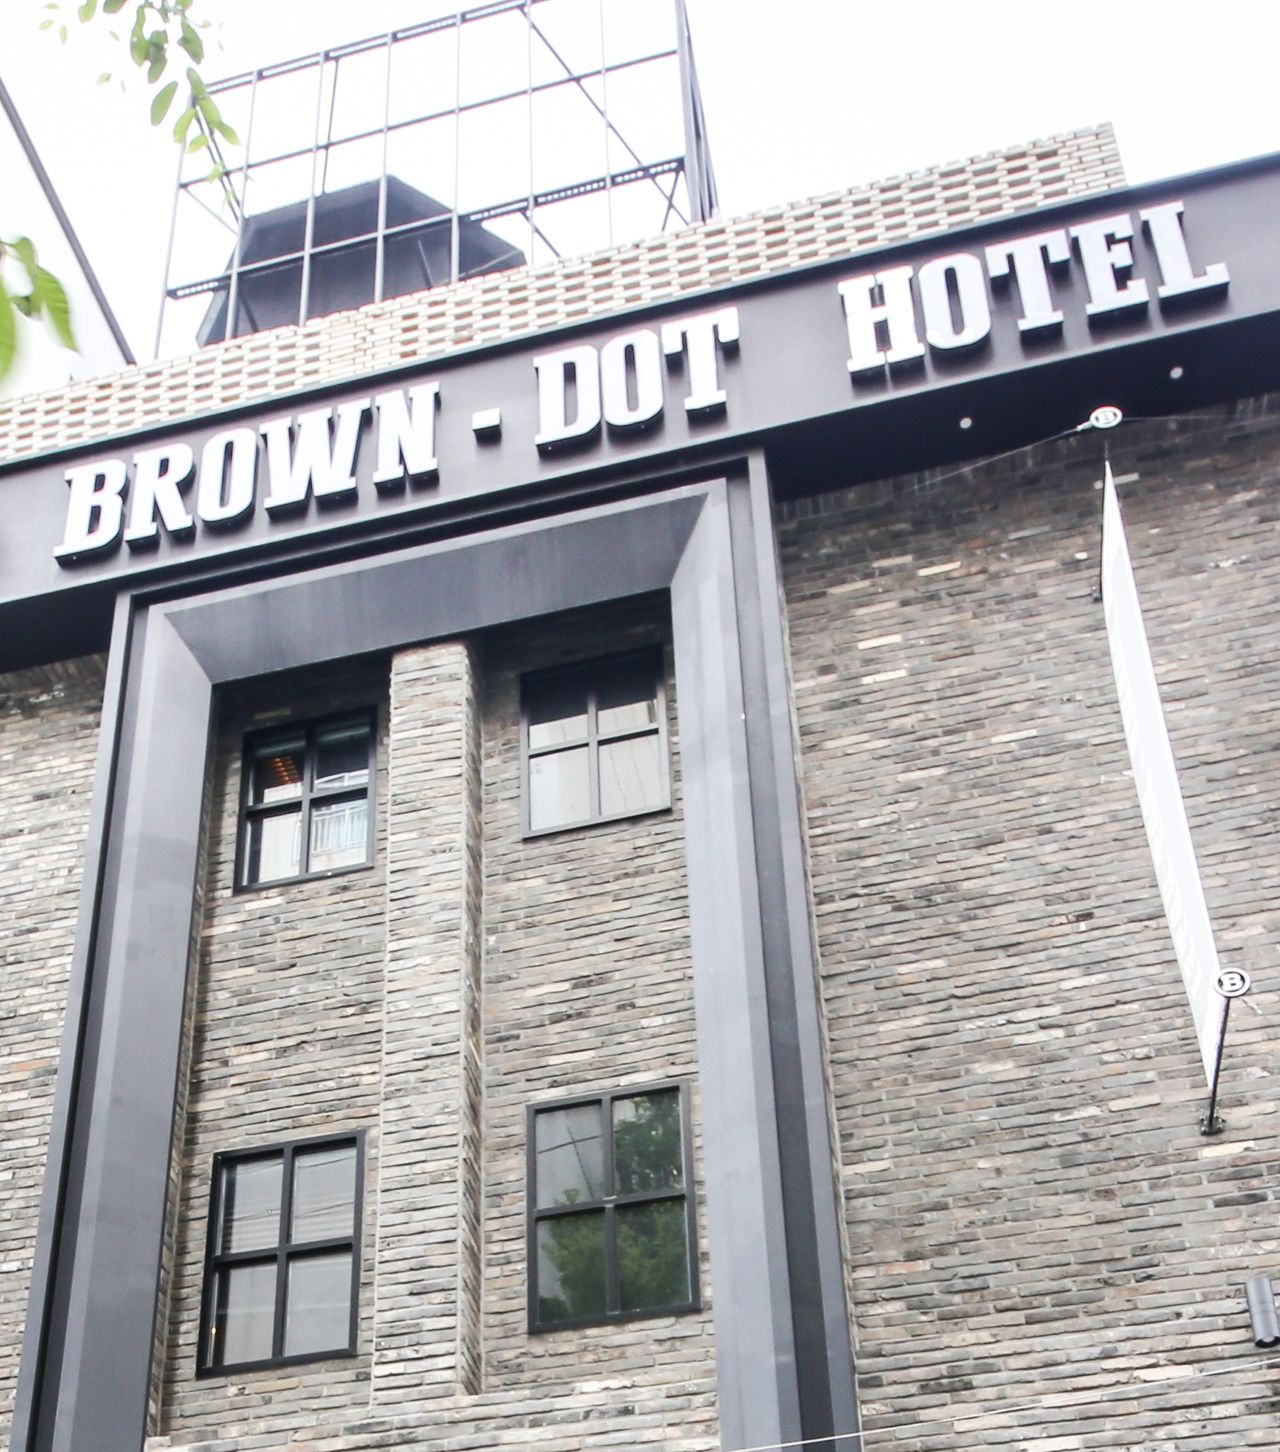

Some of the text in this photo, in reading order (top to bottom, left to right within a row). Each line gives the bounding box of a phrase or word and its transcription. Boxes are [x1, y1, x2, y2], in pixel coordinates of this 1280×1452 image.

[53, 381, 440, 558] BROWN
[533, 306, 740, 446] DOT
[837, 201, 1231, 373] HOTEL
